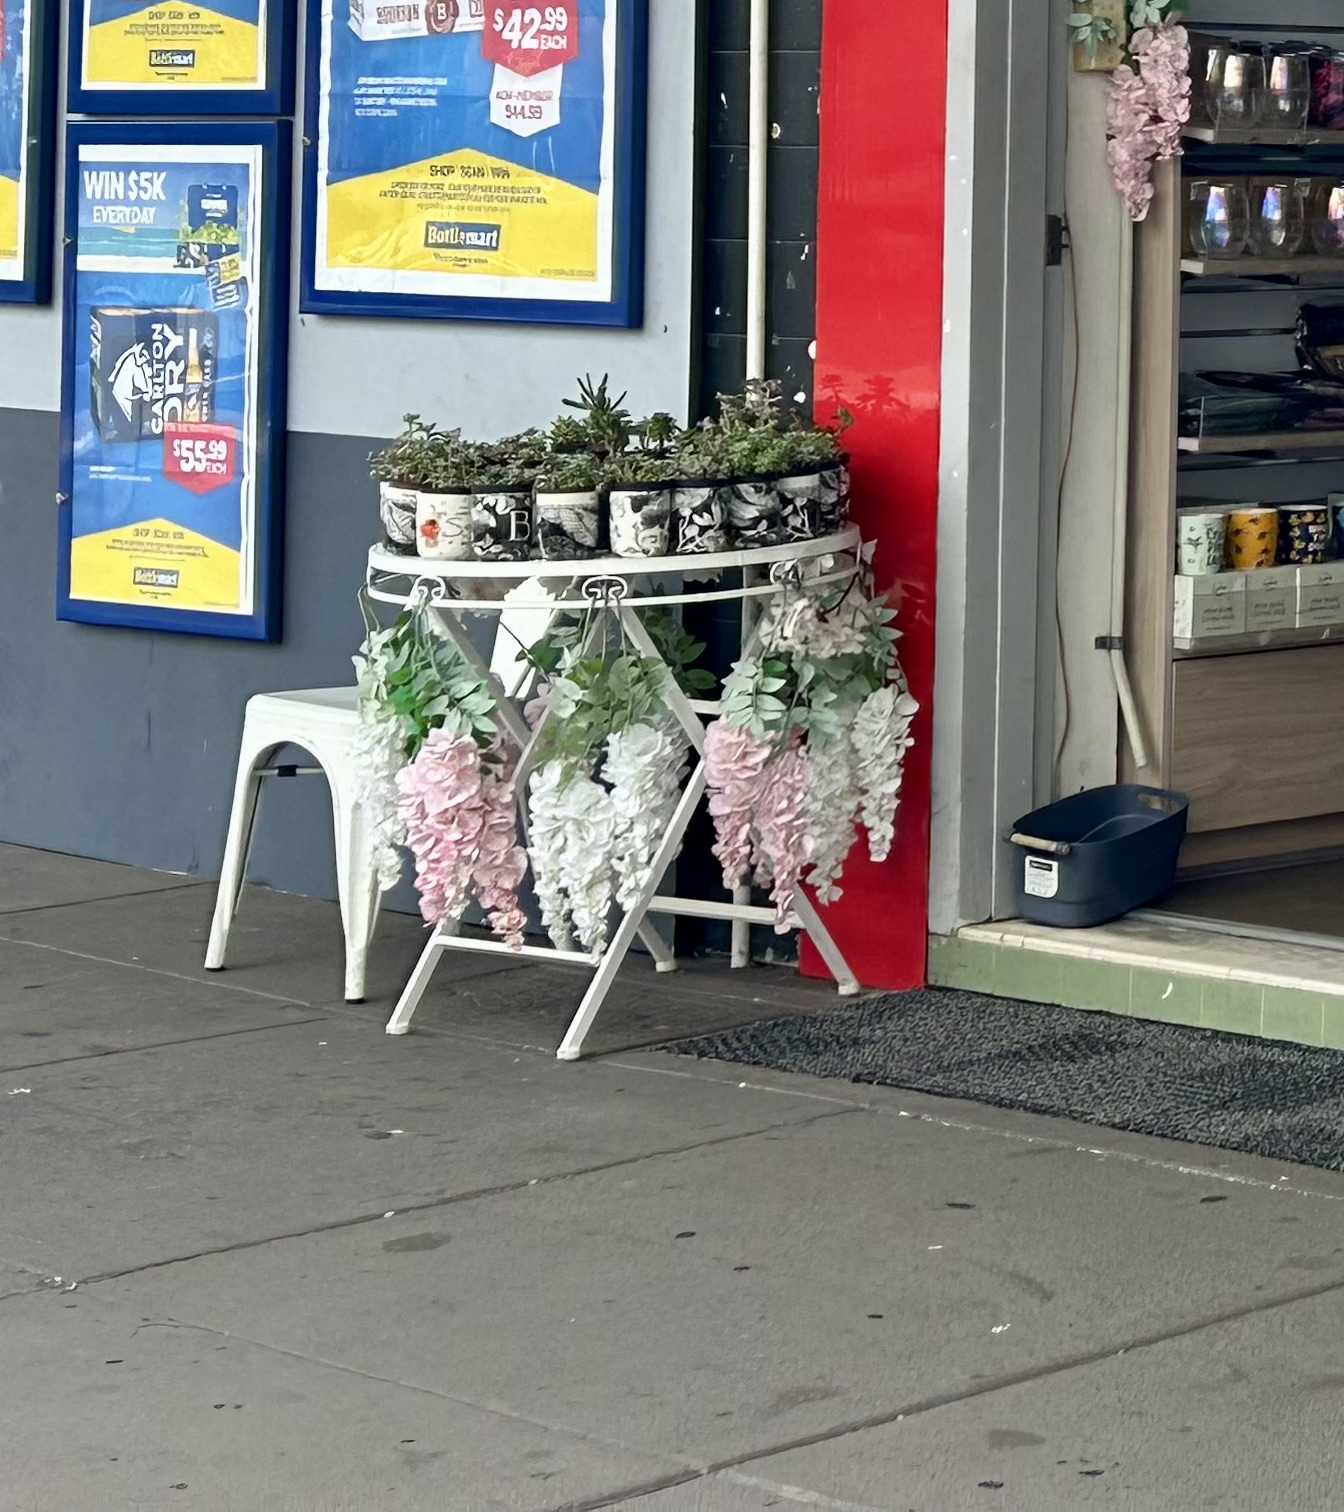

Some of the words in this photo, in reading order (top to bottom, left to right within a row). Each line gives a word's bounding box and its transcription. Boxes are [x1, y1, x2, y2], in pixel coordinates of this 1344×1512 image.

[493, 6, 568, 50] $42.99
[540, 34, 567, 50] EACH
[83, 170, 126, 201] WIN
[128, 170, 167, 201] $5K
[92, 205, 130, 226] EVERY
[130, 205, 157, 226] DAY
[427, 224, 499, 248] Bottlemart
[150, 323, 166, 435] CARLTON
[173, 438, 228, 473] $55.99
[509, 510, 531, 541] B
